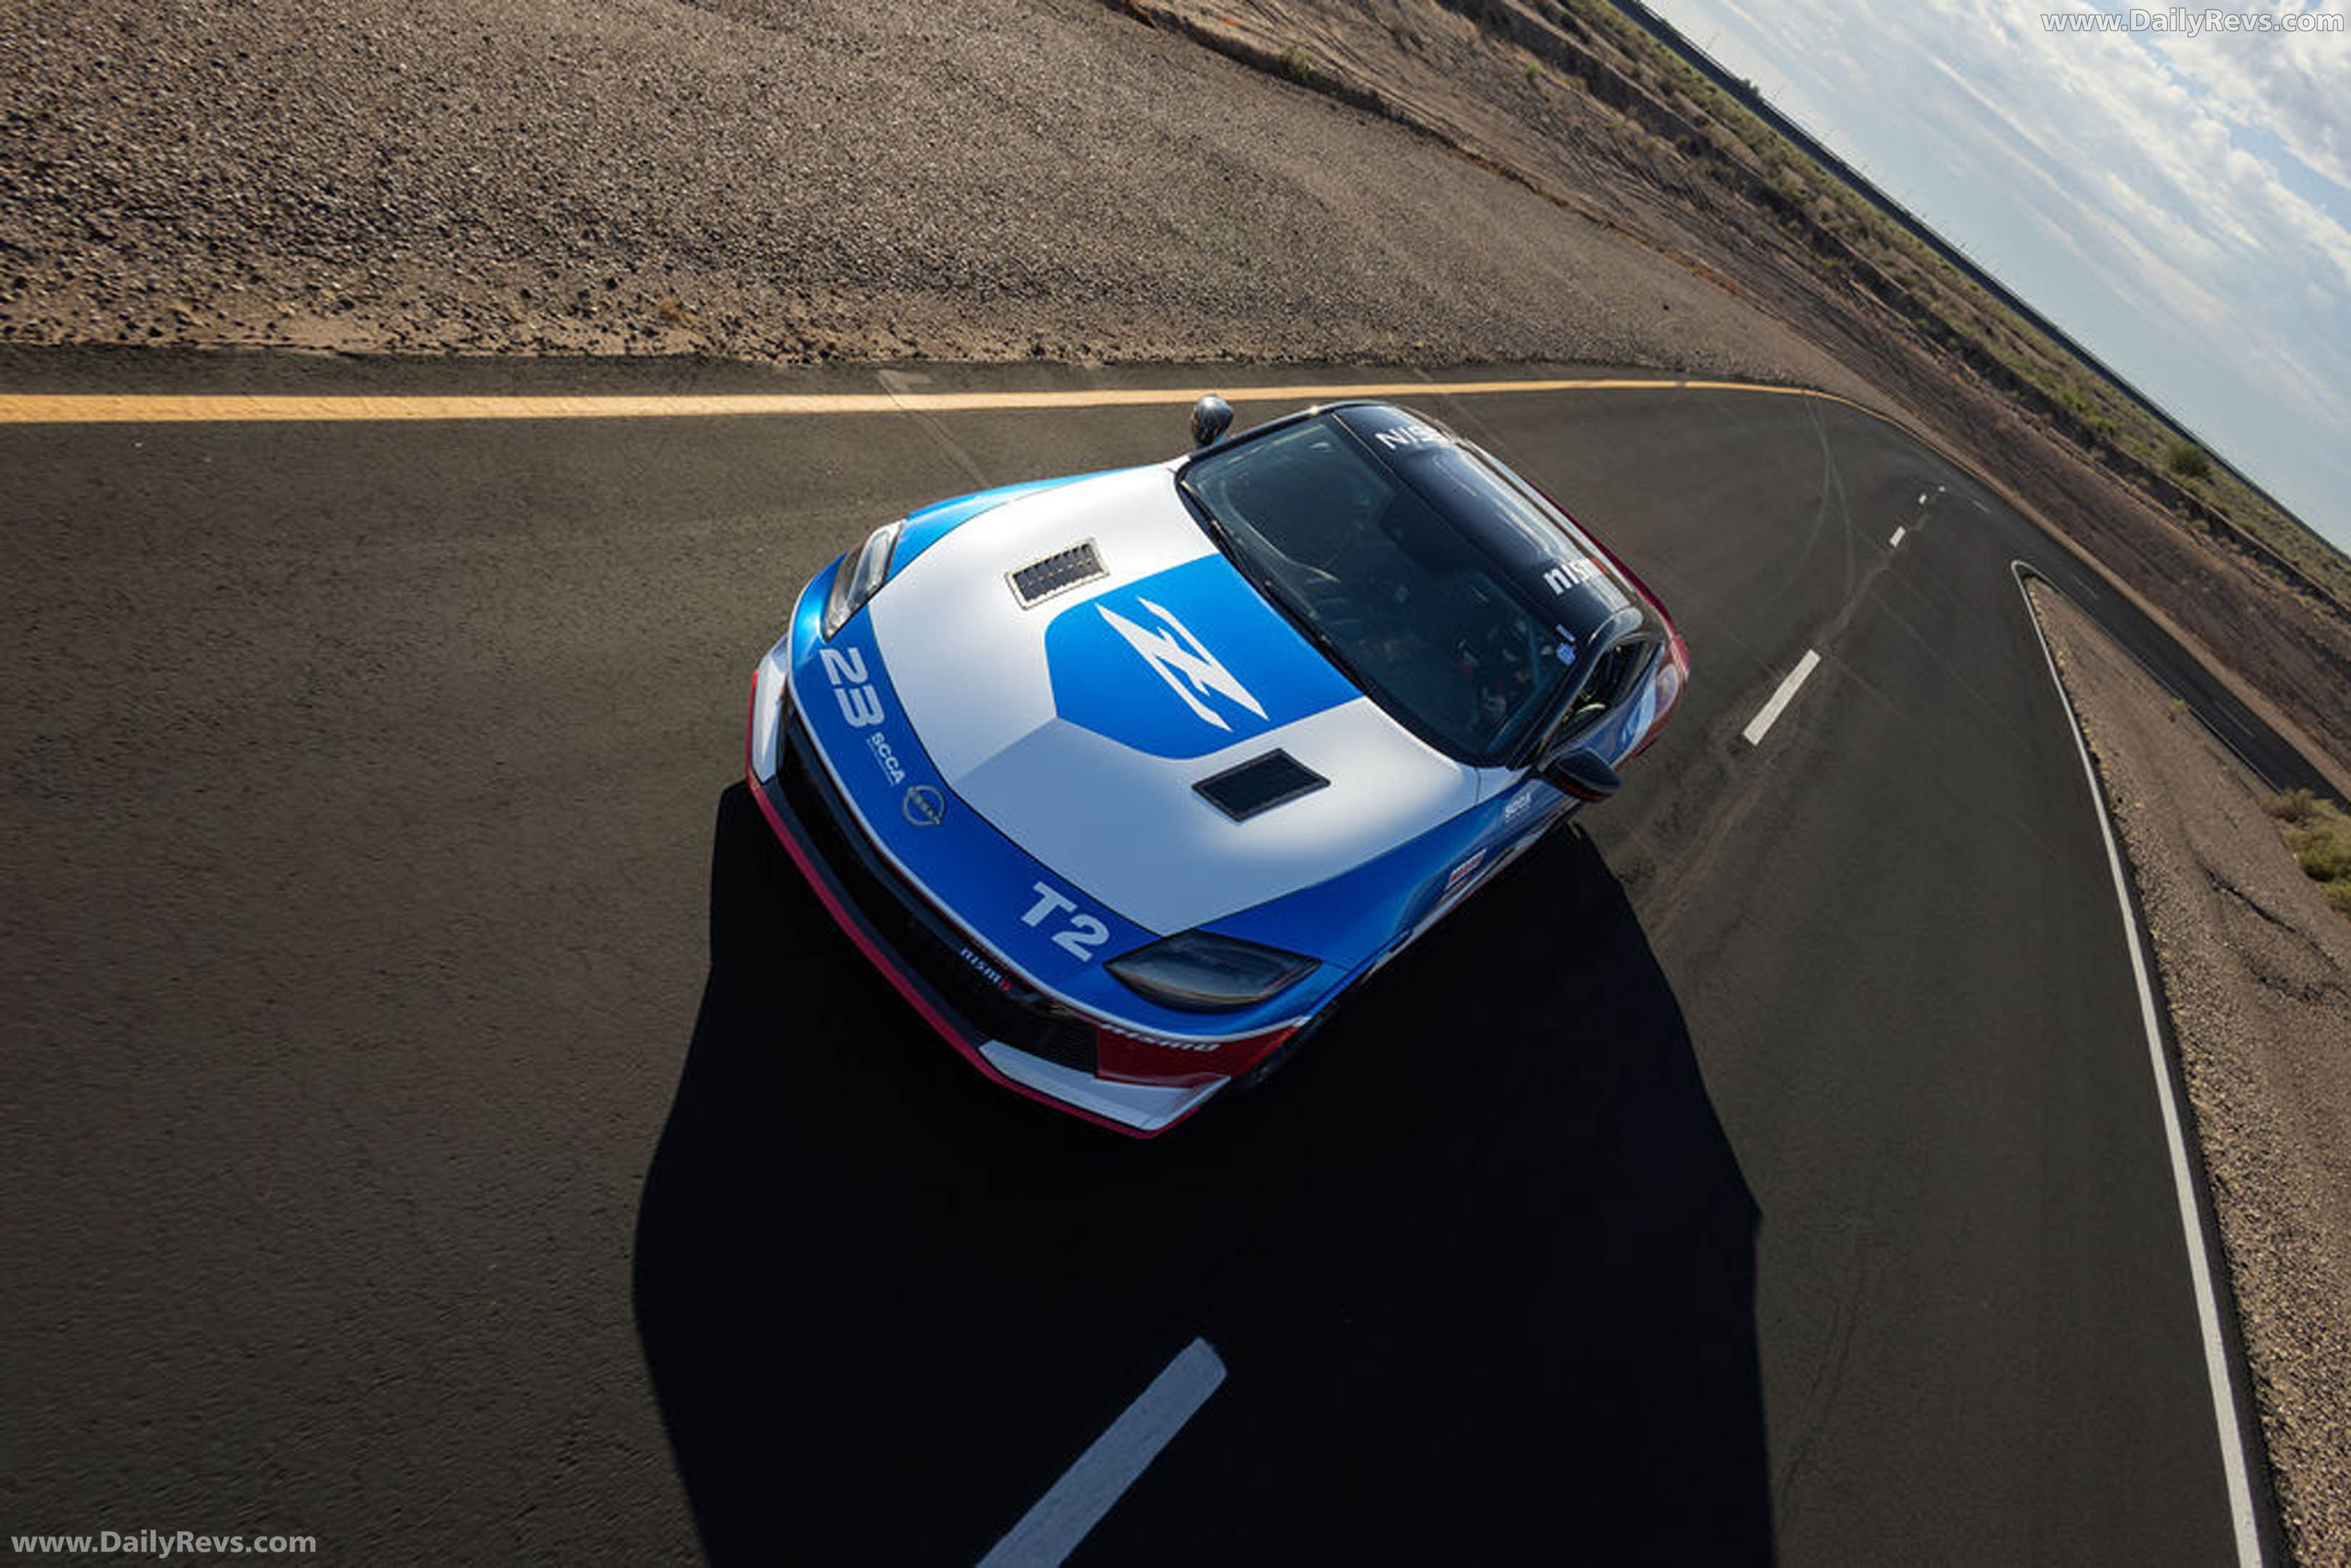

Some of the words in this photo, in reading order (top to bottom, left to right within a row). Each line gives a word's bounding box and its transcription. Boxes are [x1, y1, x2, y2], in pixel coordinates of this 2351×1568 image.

[818, 646, 886, 728] 23
[871, 731, 906, 785] SCCA
[1020, 881, 1110, 963] T2
